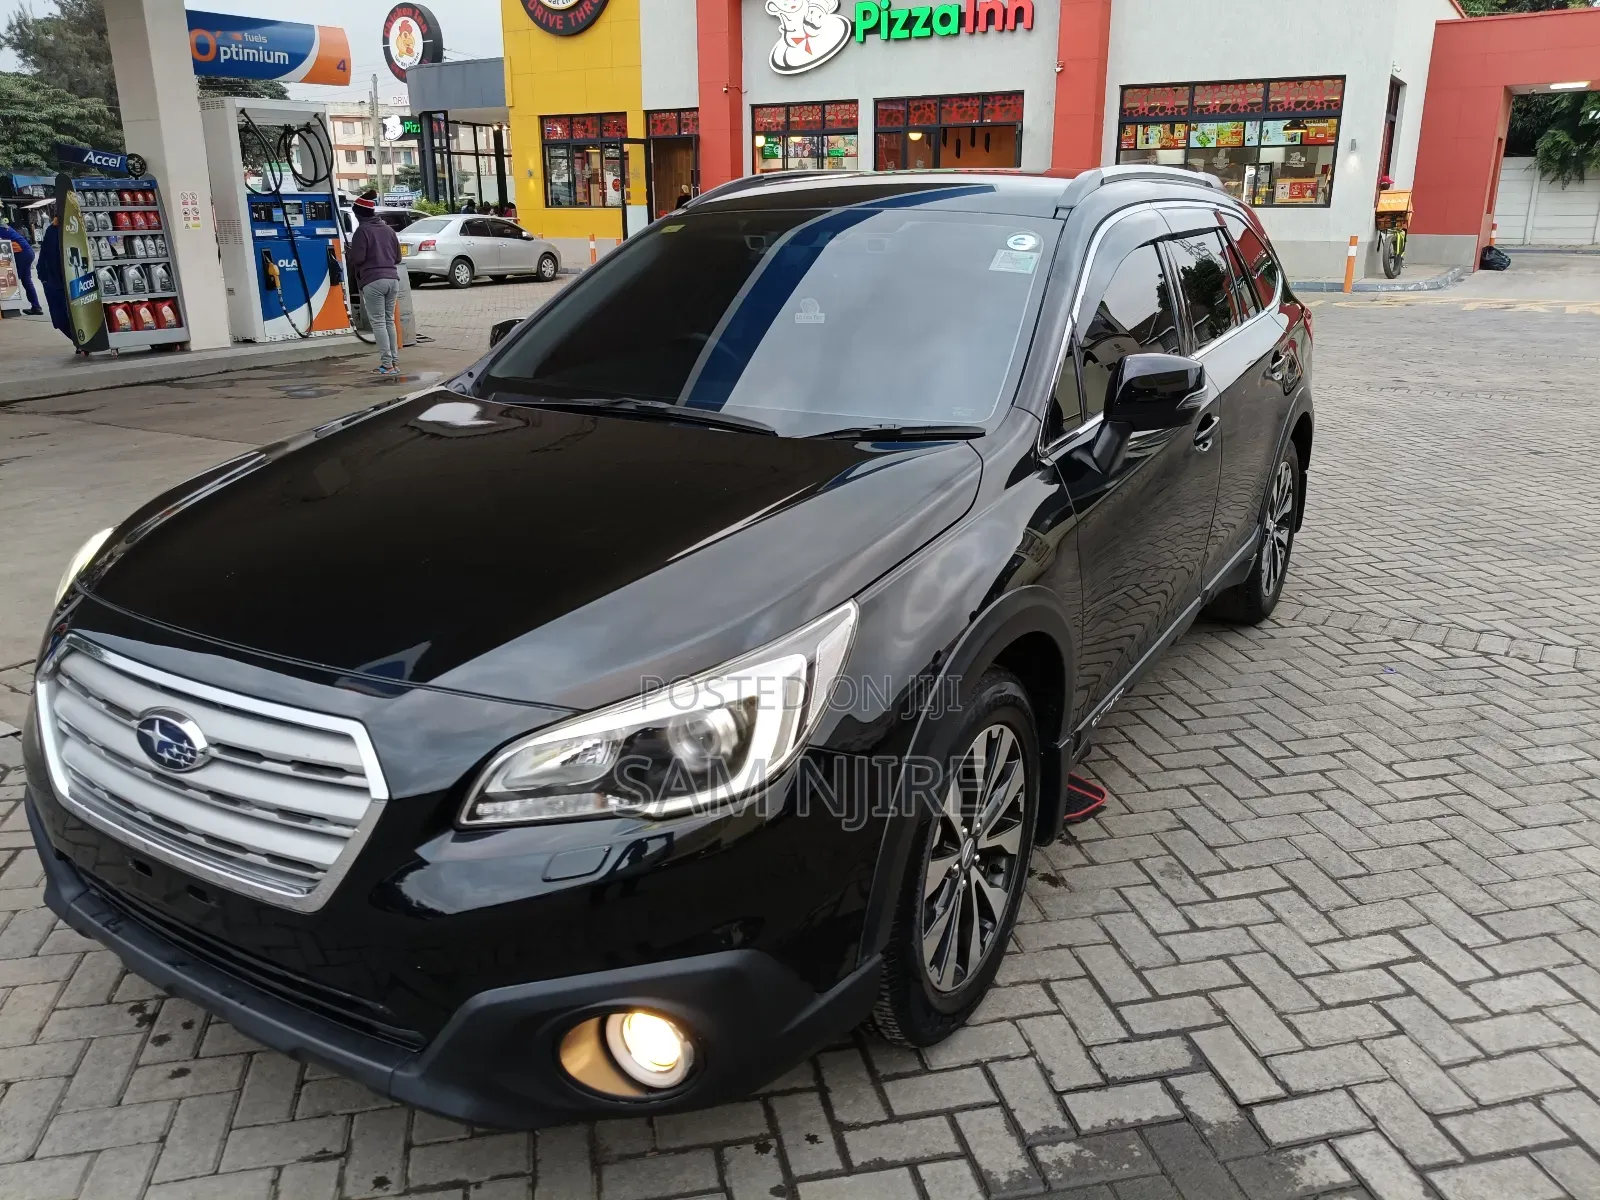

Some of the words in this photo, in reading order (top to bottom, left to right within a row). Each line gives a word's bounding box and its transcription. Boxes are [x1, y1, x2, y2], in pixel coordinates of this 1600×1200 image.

[384, 7, 413, 38] Chicken
[413, 8, 428, 34] Inn
[527, 0, 564, 30] DRIVE
[855, 0, 961, 43] Pizza
[964, 0, 1035, 34] Inn
[244, 32, 267, 44] fuels
[336, 59, 347, 73] 4
[83, 150, 121, 168] Accel
[278, 258, 299, 268] OLA
[78, 275, 96, 293] Accel
[80, 292, 99, 306] FUSION
